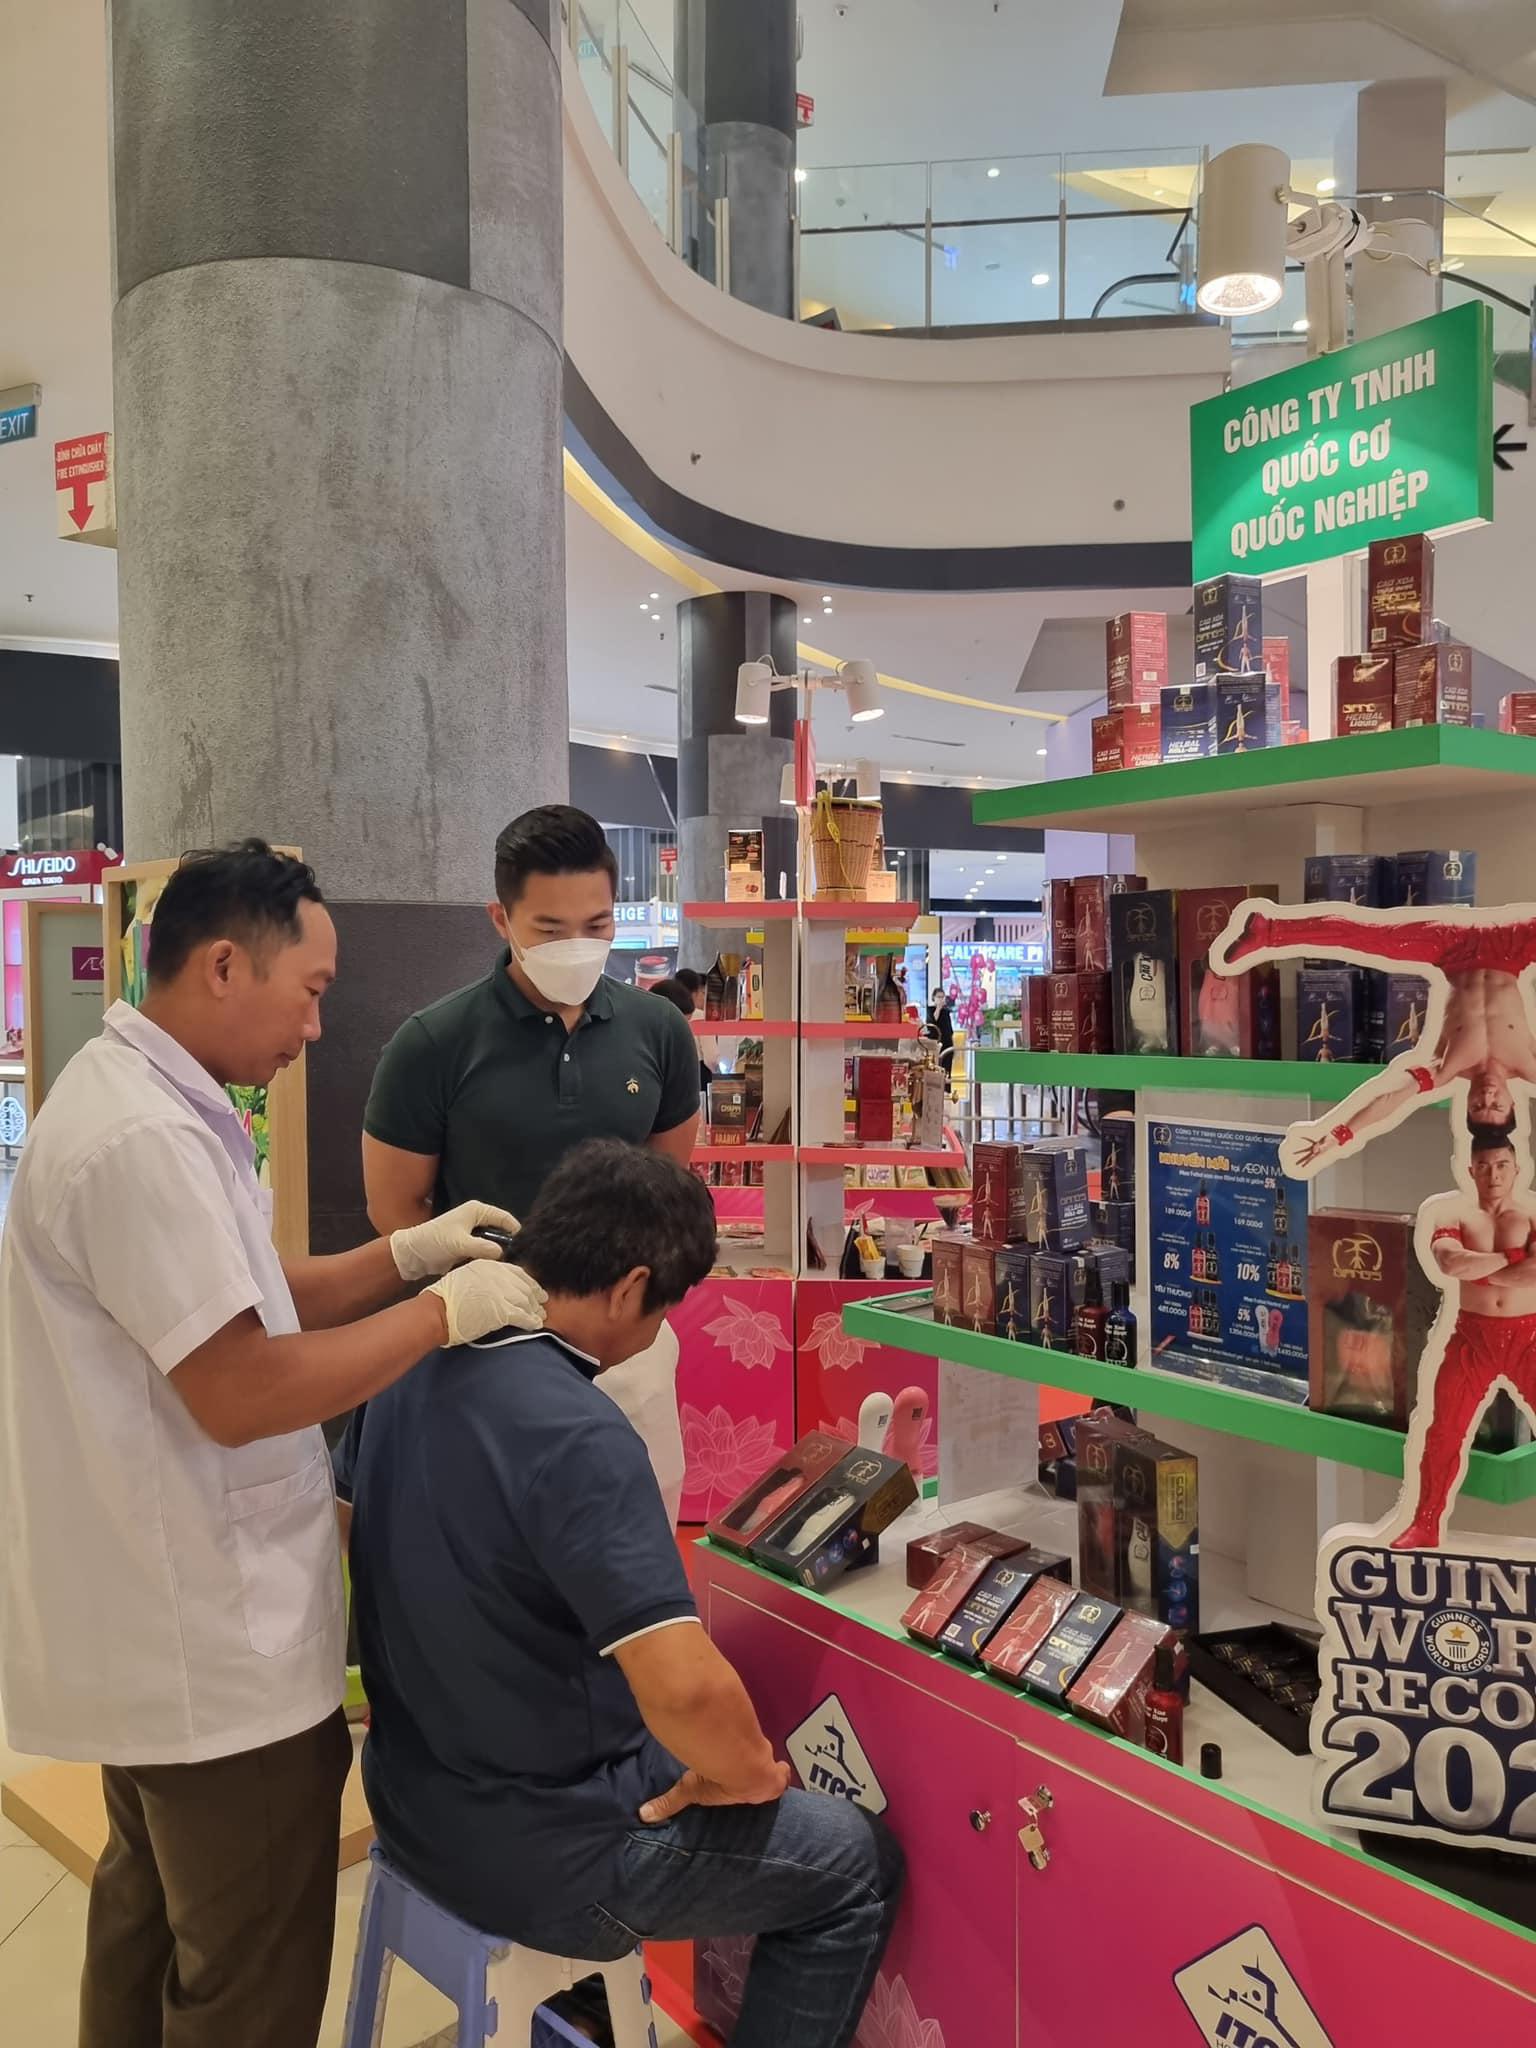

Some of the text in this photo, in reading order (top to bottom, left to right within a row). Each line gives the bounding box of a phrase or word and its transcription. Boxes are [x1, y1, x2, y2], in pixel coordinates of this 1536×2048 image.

[1223, 349, 1437, 455] CÔNG TY TNHH
[0, 412, 29, 439] EXIT
[1261, 418, 1393, 496] QUỐC CƠ
[56, 468, 68, 480] FIRE
[1230, 469, 1430, 560] QUỐC NGHIỆP
[7, 856, 76, 876] SHISEIDO
[1163, 1252, 1180, 1270] 8%
[1237, 1262, 1260, 1282] 10%
[1237, 1308, 1251, 1322] 5%
[1333, 1550, 1536, 1616] GUIN
[1431, 1612, 1484, 1634] GUINNESS
[1425, 1634, 1490, 1672] WORLD RECORDS
[1336, 1662, 1536, 1731] RECO
